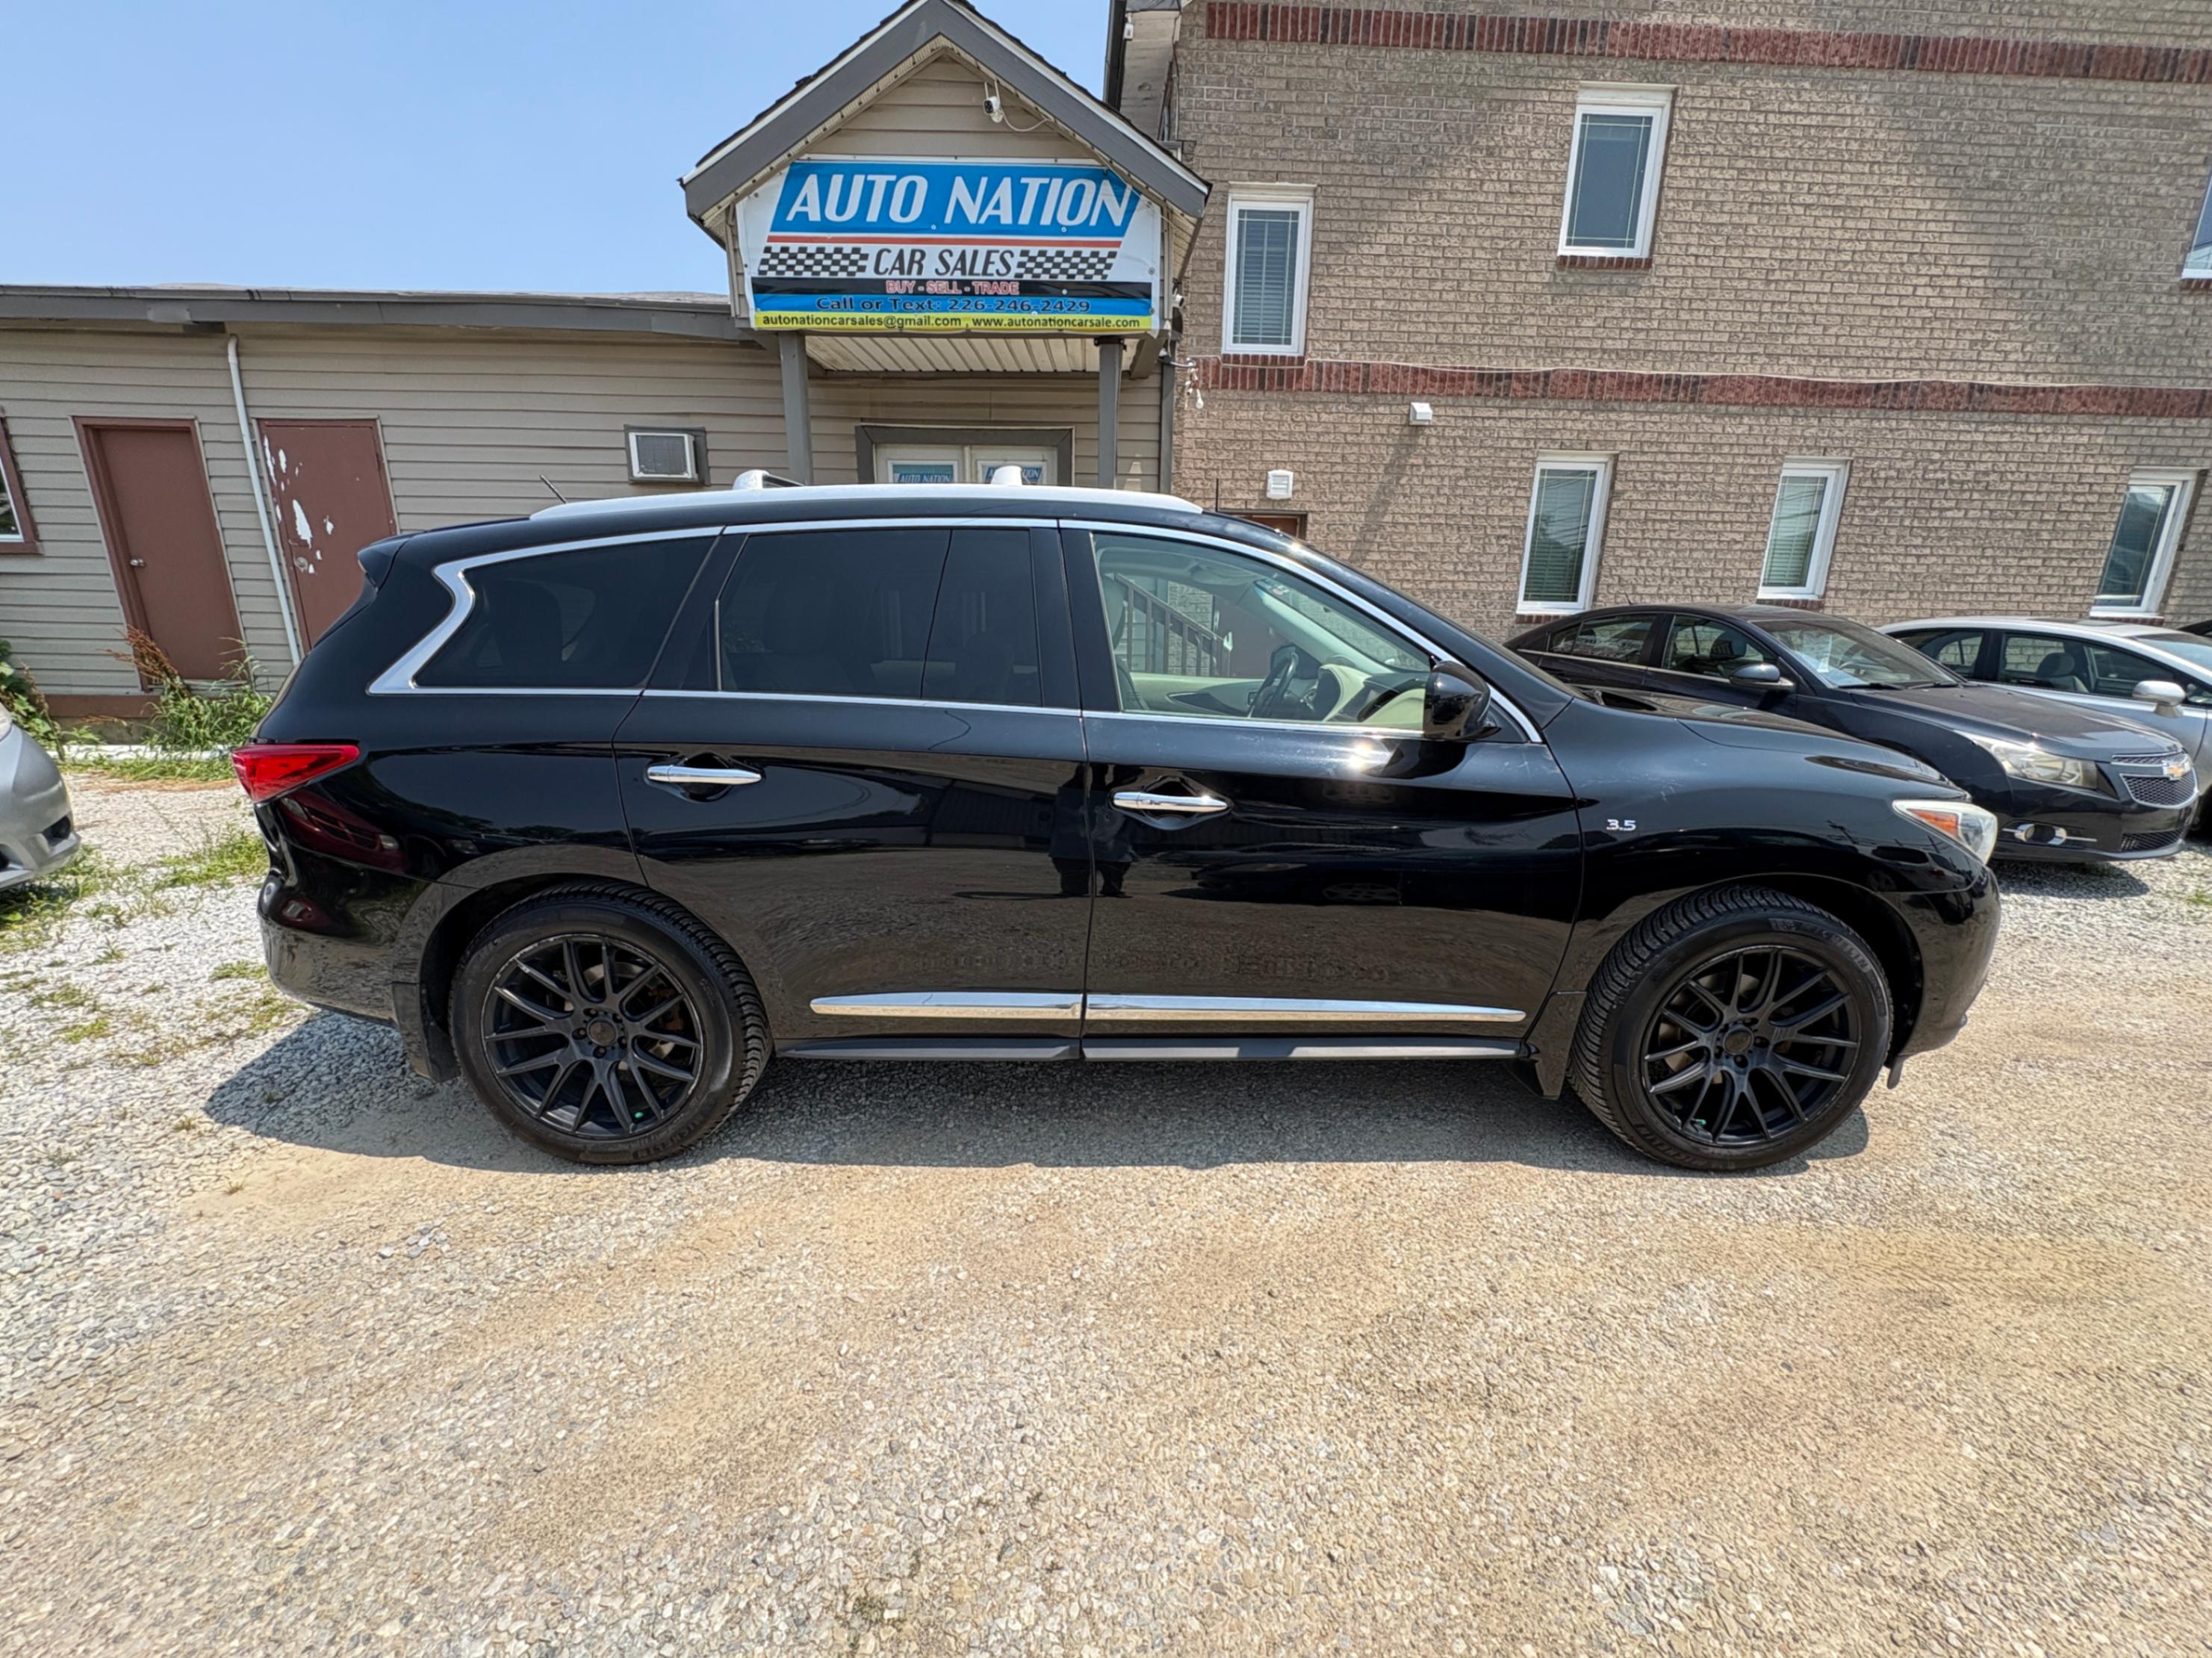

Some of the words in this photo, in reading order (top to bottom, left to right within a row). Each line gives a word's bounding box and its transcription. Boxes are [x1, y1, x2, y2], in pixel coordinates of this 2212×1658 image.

[786, 174, 928, 223] AUTO
[944, 176, 1132, 227] NATION
[873, 248, 927, 276] CAR
[934, 249, 1015, 277] SALES
[886, 280, 916, 294] BUY
[926, 280, 963, 294] SELL
[972, 281, 1020, 295] TRADE
[817, 298, 854, 311] Call
[860, 301, 883, 311] or
[889, 299, 941, 311] Text:
[948, 299, 1091, 312] 226-246-2429
[762, 314, 961, 329] autonationcarsales@gmail.com
[973, 316, 1140, 328] www.autonationcarsale.com
[898, 473, 920, 484] AUTO
[922, 473, 952, 484] NATION
[1606, 819, 1636, 831] 3.5
